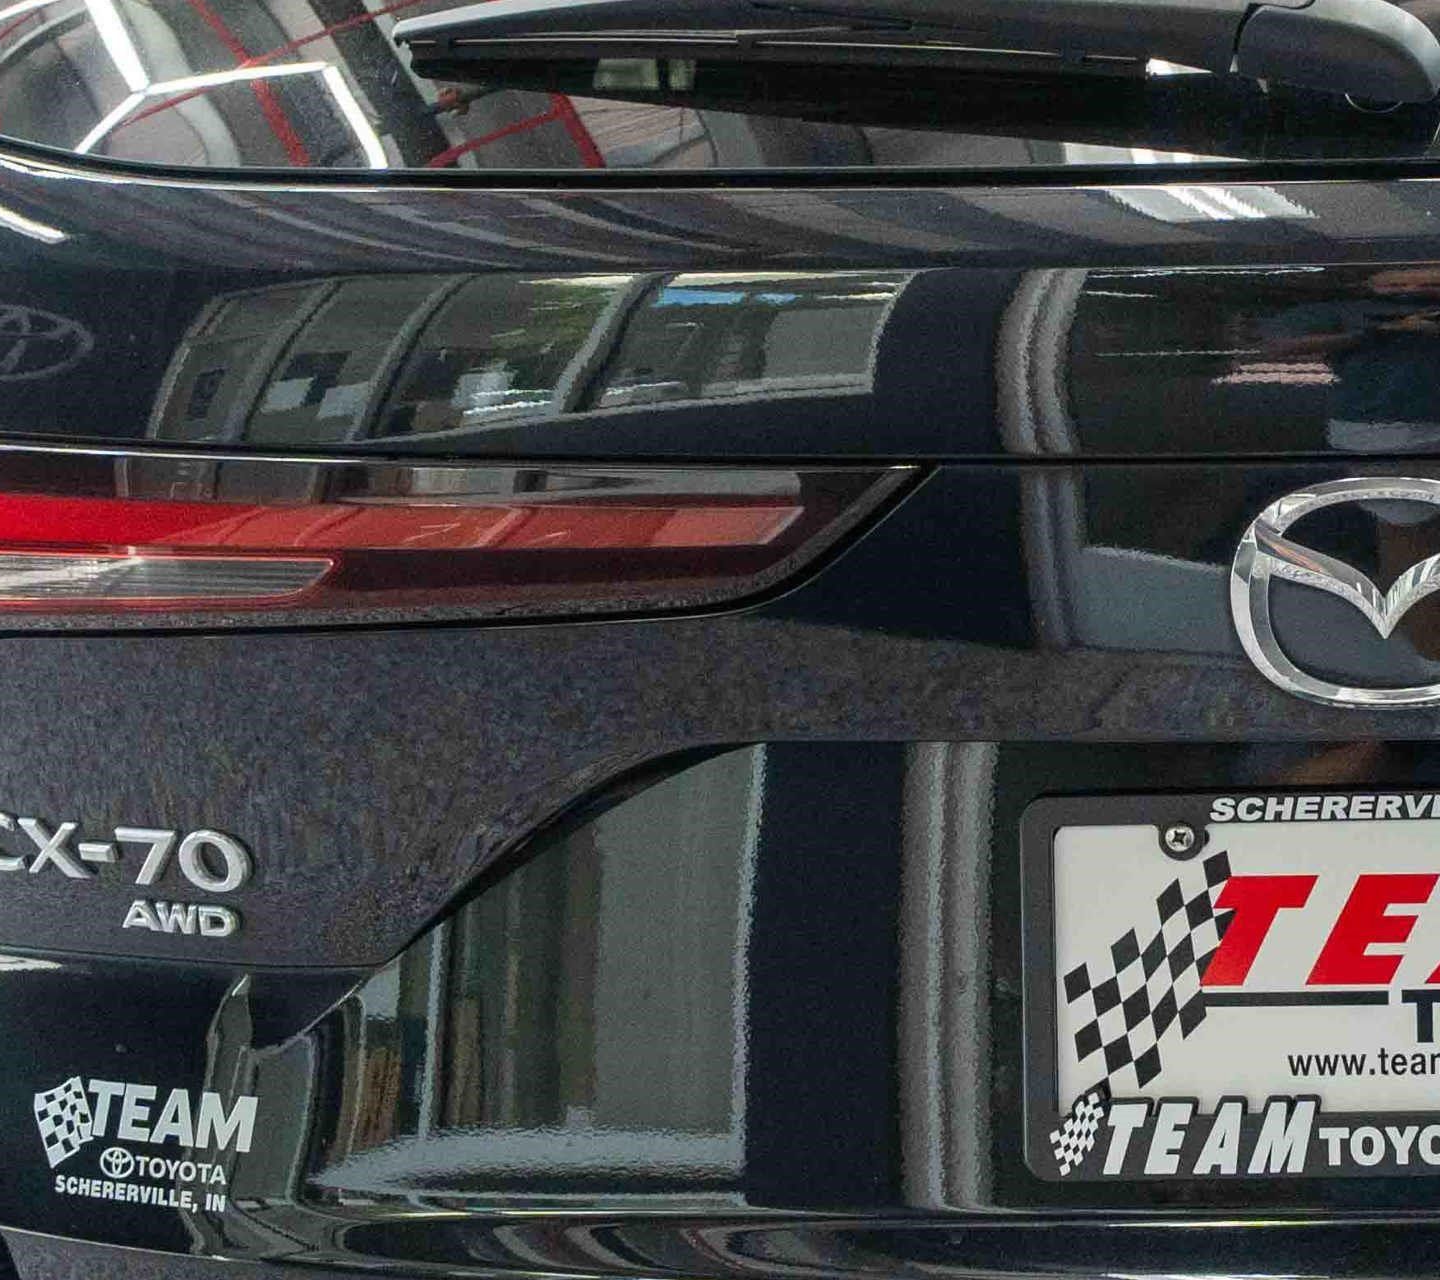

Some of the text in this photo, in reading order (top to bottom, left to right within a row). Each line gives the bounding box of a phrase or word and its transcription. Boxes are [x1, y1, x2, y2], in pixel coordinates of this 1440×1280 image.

[122, 899, 241, 937] AWD
[86, 1078, 259, 1154] TEAM
[134, 1154, 227, 1186] TOYOTA
[53, 1174, 227, 1214] SCHERERVILLE, IN
